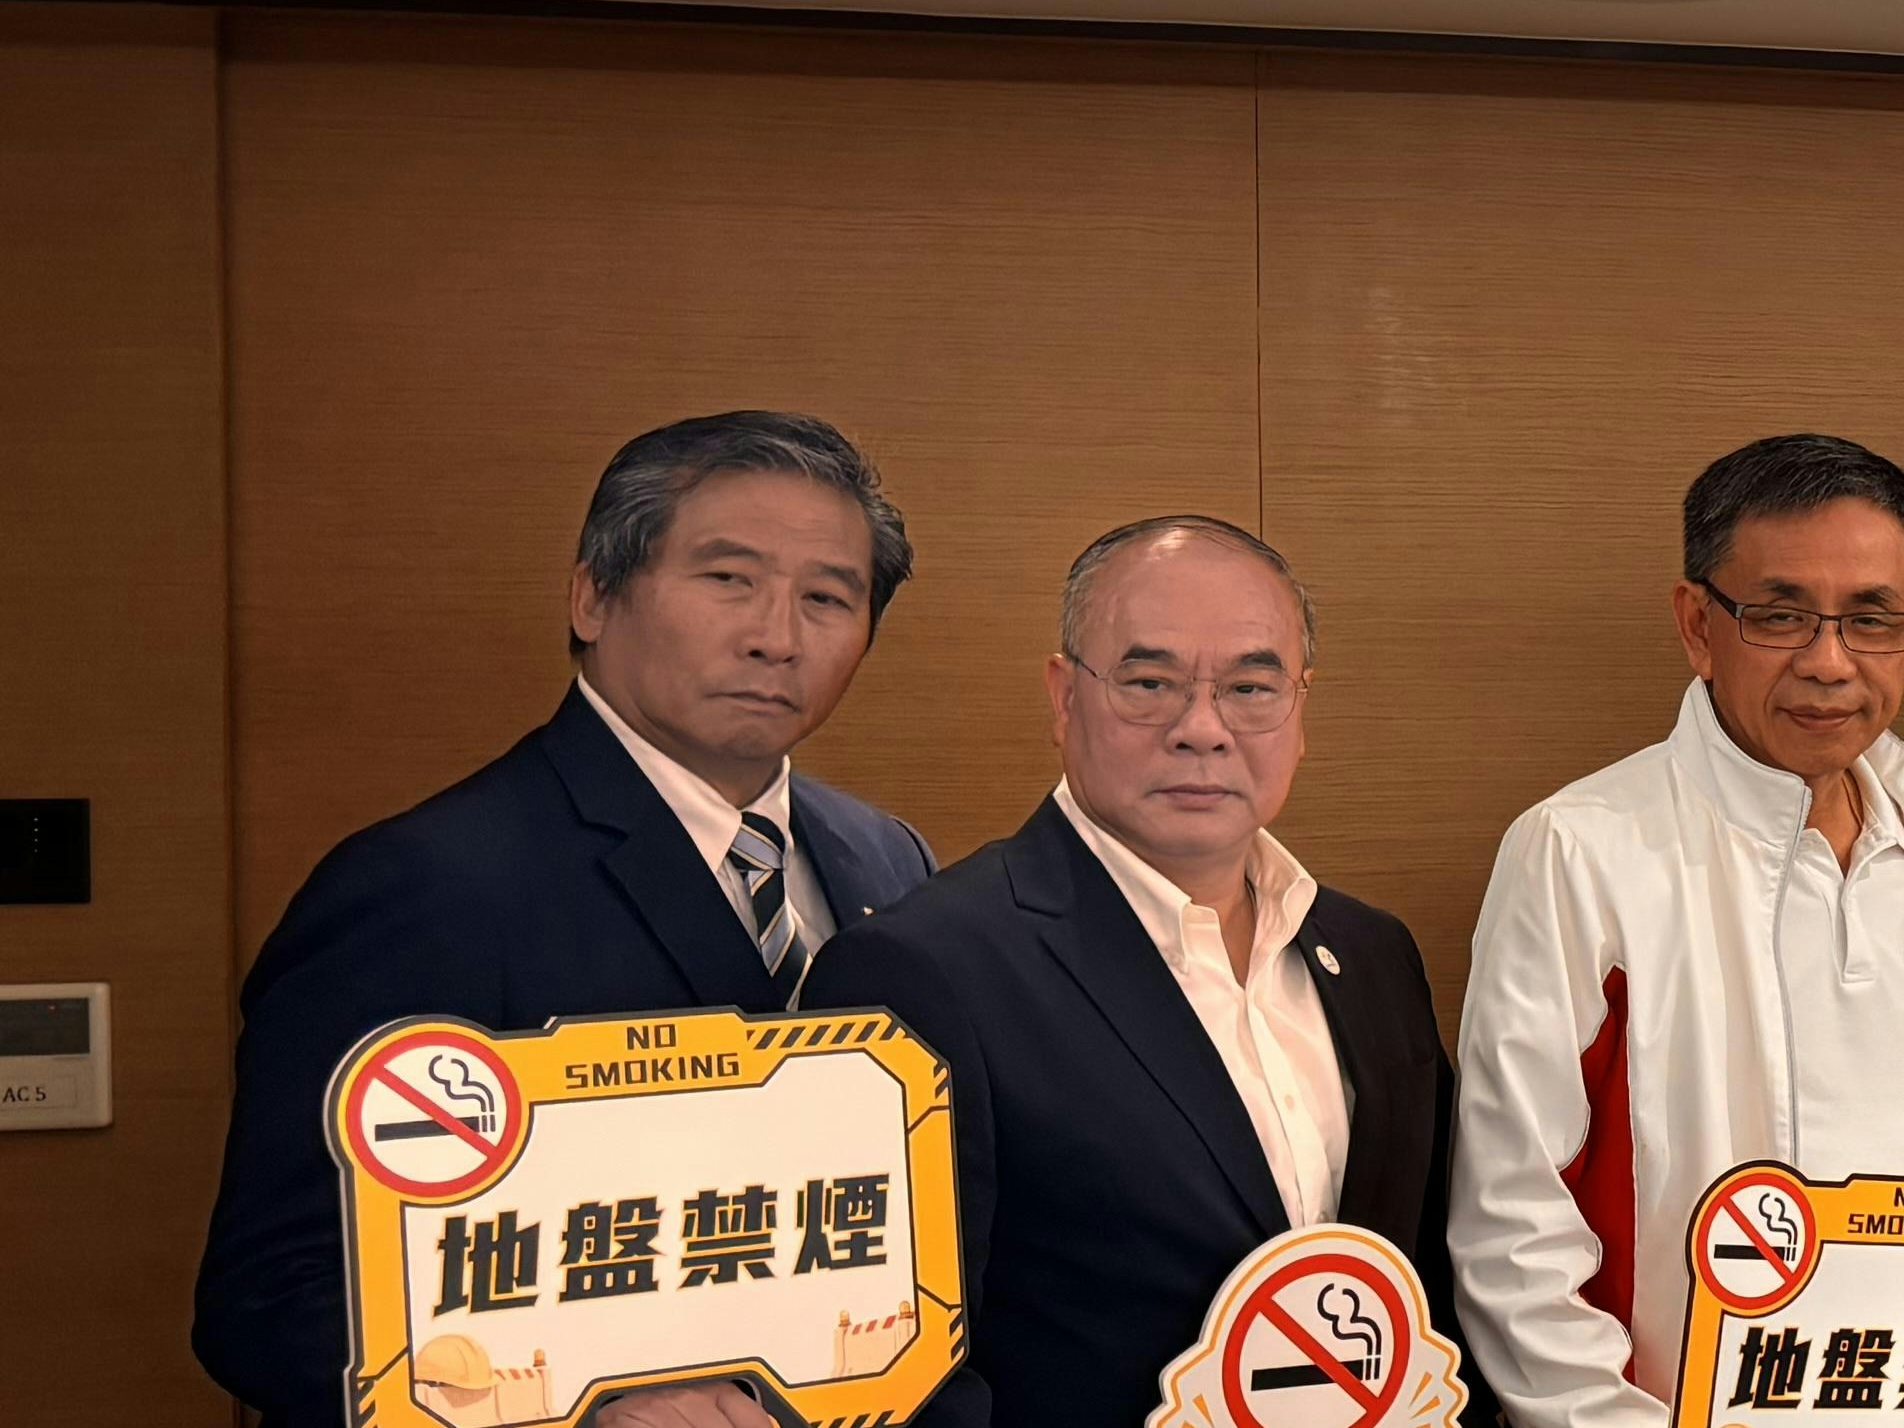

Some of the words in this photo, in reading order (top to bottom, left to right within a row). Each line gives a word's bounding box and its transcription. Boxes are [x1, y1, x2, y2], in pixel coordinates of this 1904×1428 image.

[626, 1023, 678, 1050] NO
[564, 1053, 740, 1090] SMOKING
[433, 1172, 891, 1319] 地盤禁煙
